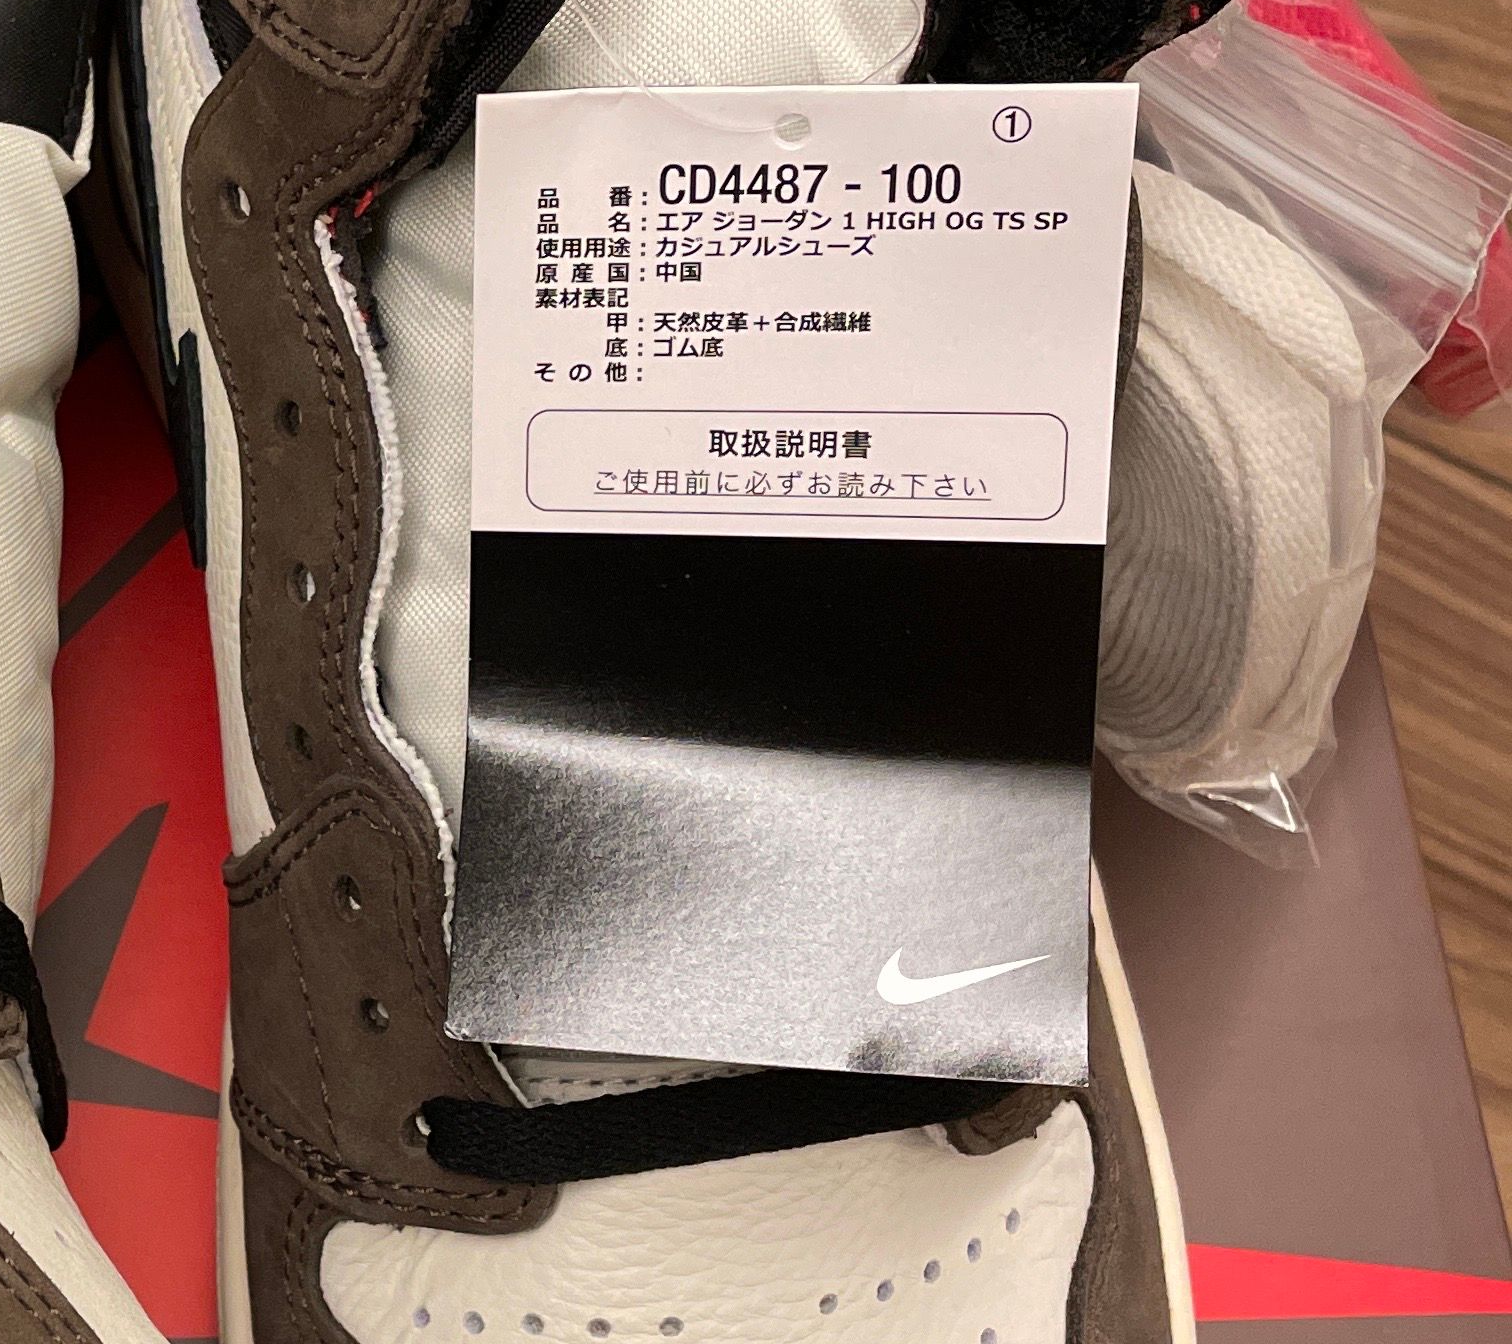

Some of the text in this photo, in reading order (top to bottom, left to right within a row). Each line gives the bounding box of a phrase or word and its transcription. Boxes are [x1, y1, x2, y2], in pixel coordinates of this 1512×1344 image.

[658, 162, 829, 206] CD4487
[880, 162, 962, 205] 100
[865, 211, 937, 231] HIGH
[944, 211, 985, 231] OG
[992, 211, 1026, 231] TS
[1033, 211, 1070, 231] SP
[655, 260, 703, 283] 中国
[534, 286, 630, 309] 素材表記
[652, 336, 725, 359] ゴム底
[707, 428, 873, 461] 取扱説明書
[593, 467, 989, 500] ご使用前に必ずお読み下さい
